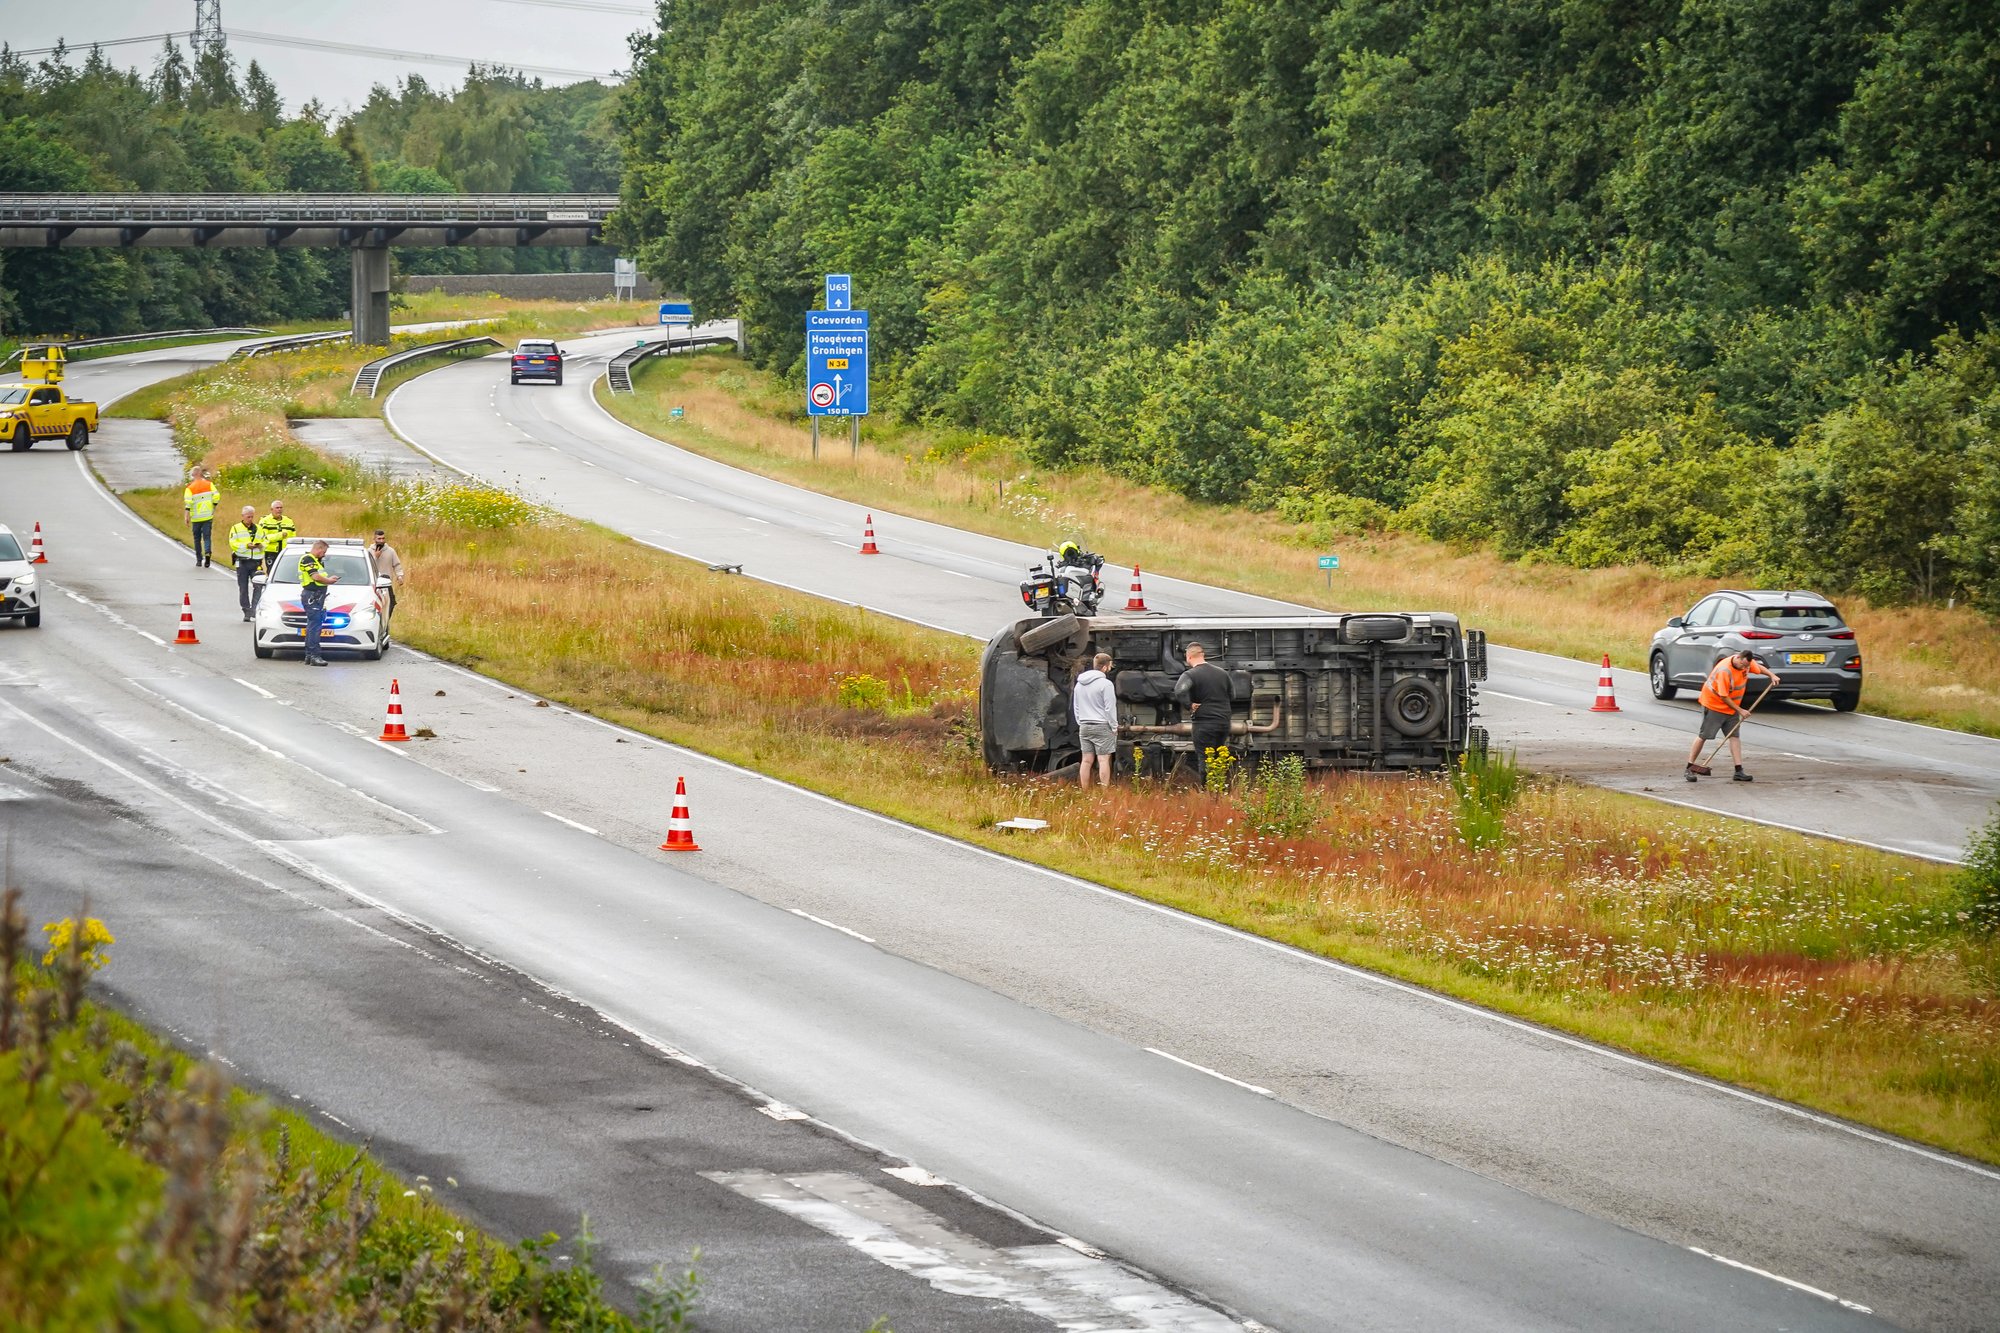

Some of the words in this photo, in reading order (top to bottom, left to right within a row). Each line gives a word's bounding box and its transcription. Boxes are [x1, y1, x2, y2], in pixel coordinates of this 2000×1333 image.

[829, 283, 848, 291] U65
[811, 316, 863, 325] Coevorden
[811, 335, 864, 345] Hoogeveen
[812, 346, 863, 357] Groningen
